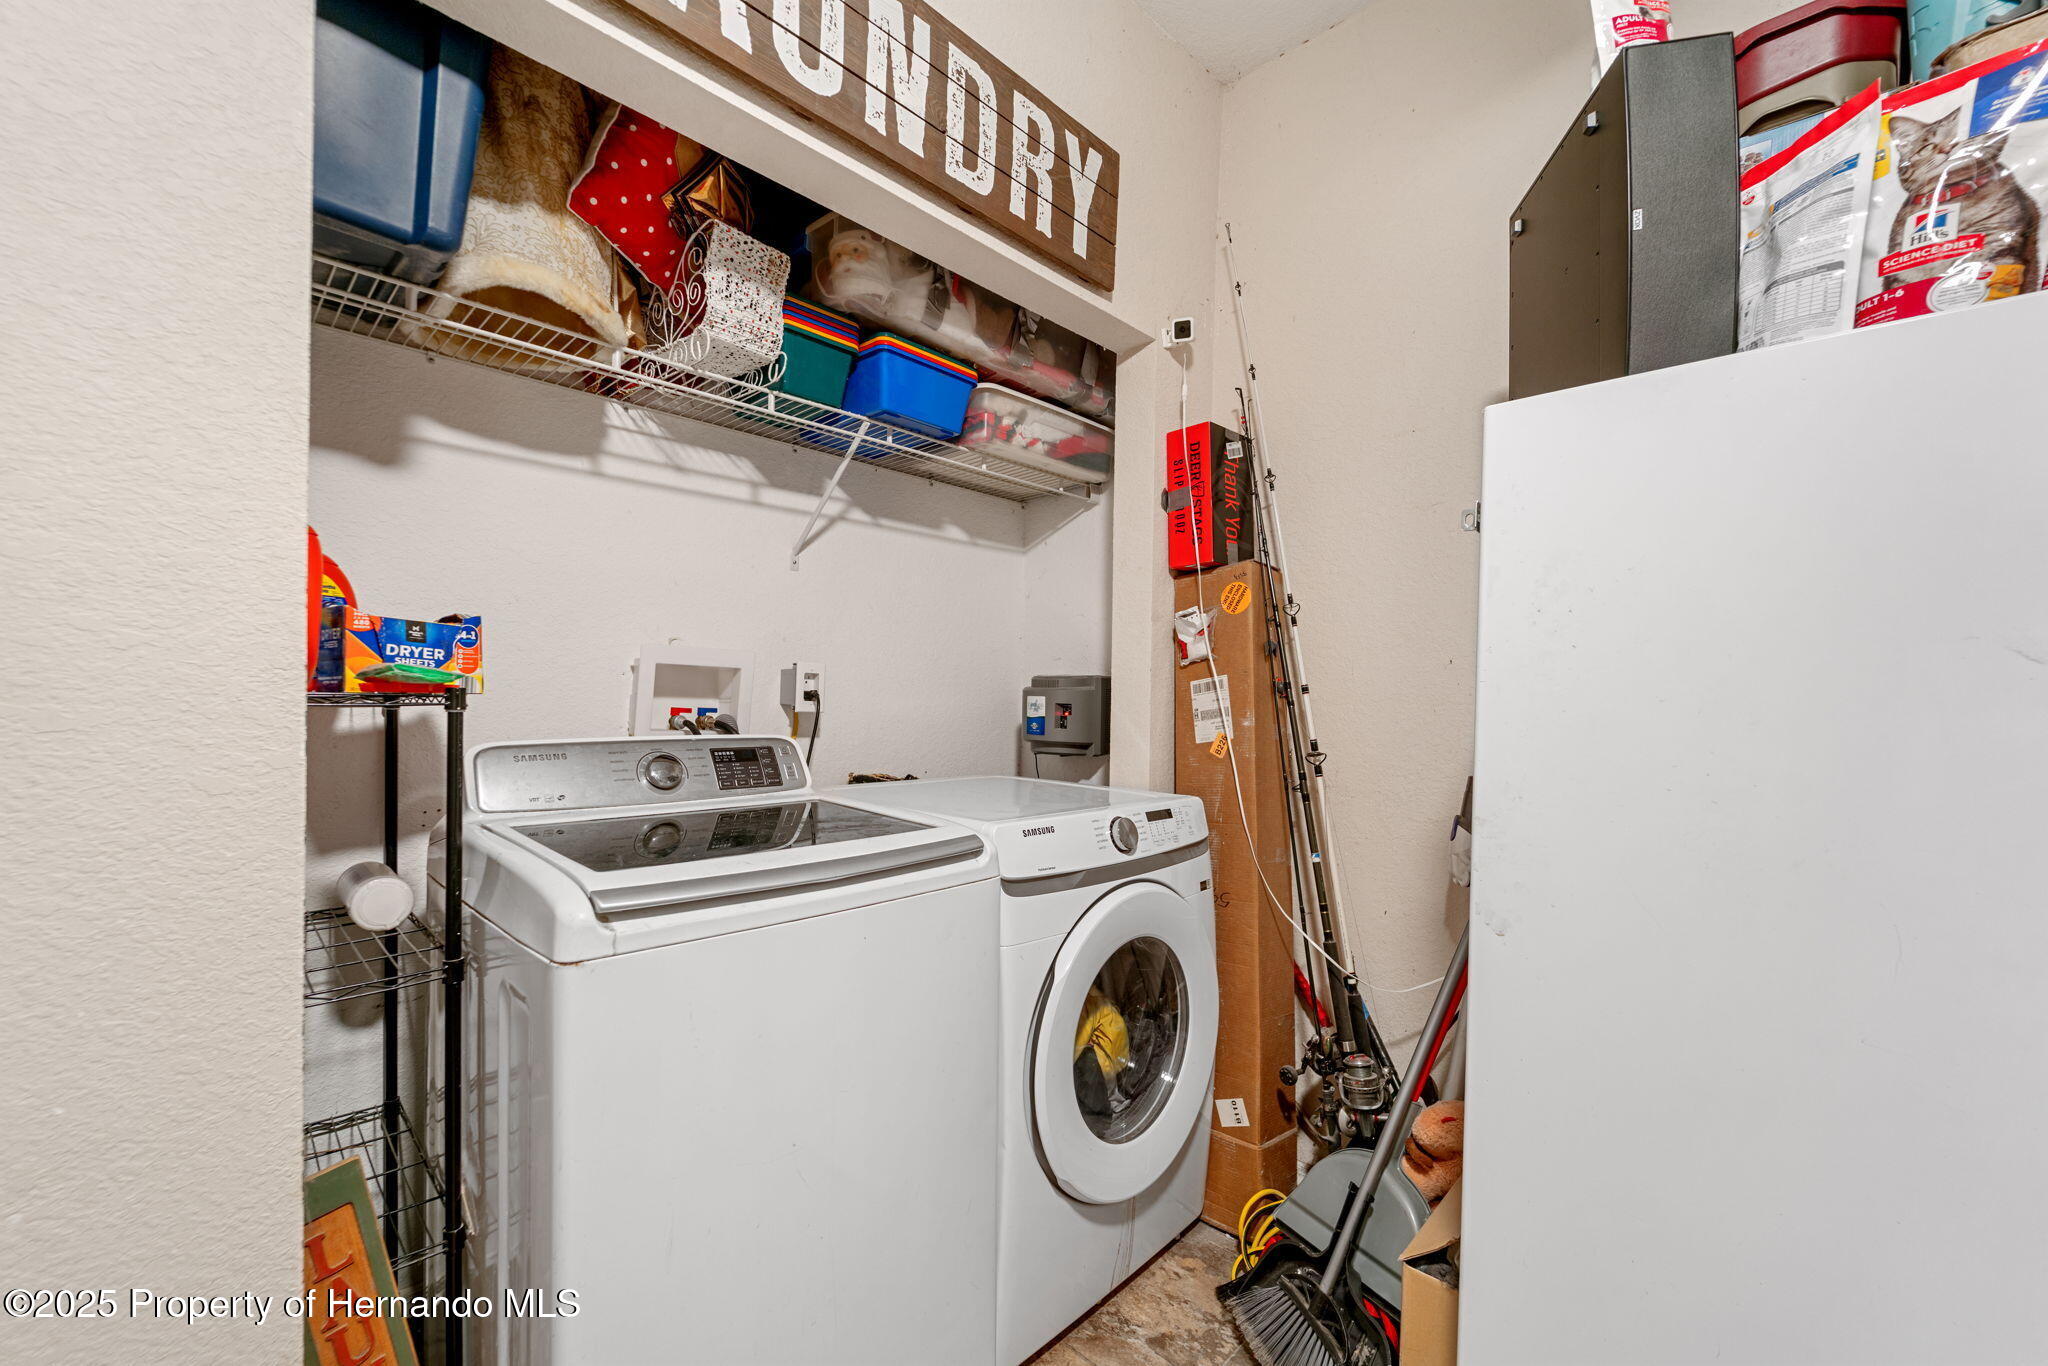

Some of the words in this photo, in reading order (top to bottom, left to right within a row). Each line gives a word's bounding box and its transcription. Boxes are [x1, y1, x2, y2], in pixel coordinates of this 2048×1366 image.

[1940, 237, 1979, 252] DIET
[1882, 288, 1905, 302] 1-6
[1190, 441, 1202, 481] DEER
[385, 643, 446, 661] DRYER
[394, 656, 436, 668] SHEETS
[512, 752, 568, 763] SAMSUNG
[1022, 825, 1056, 838] SAMSUNG
